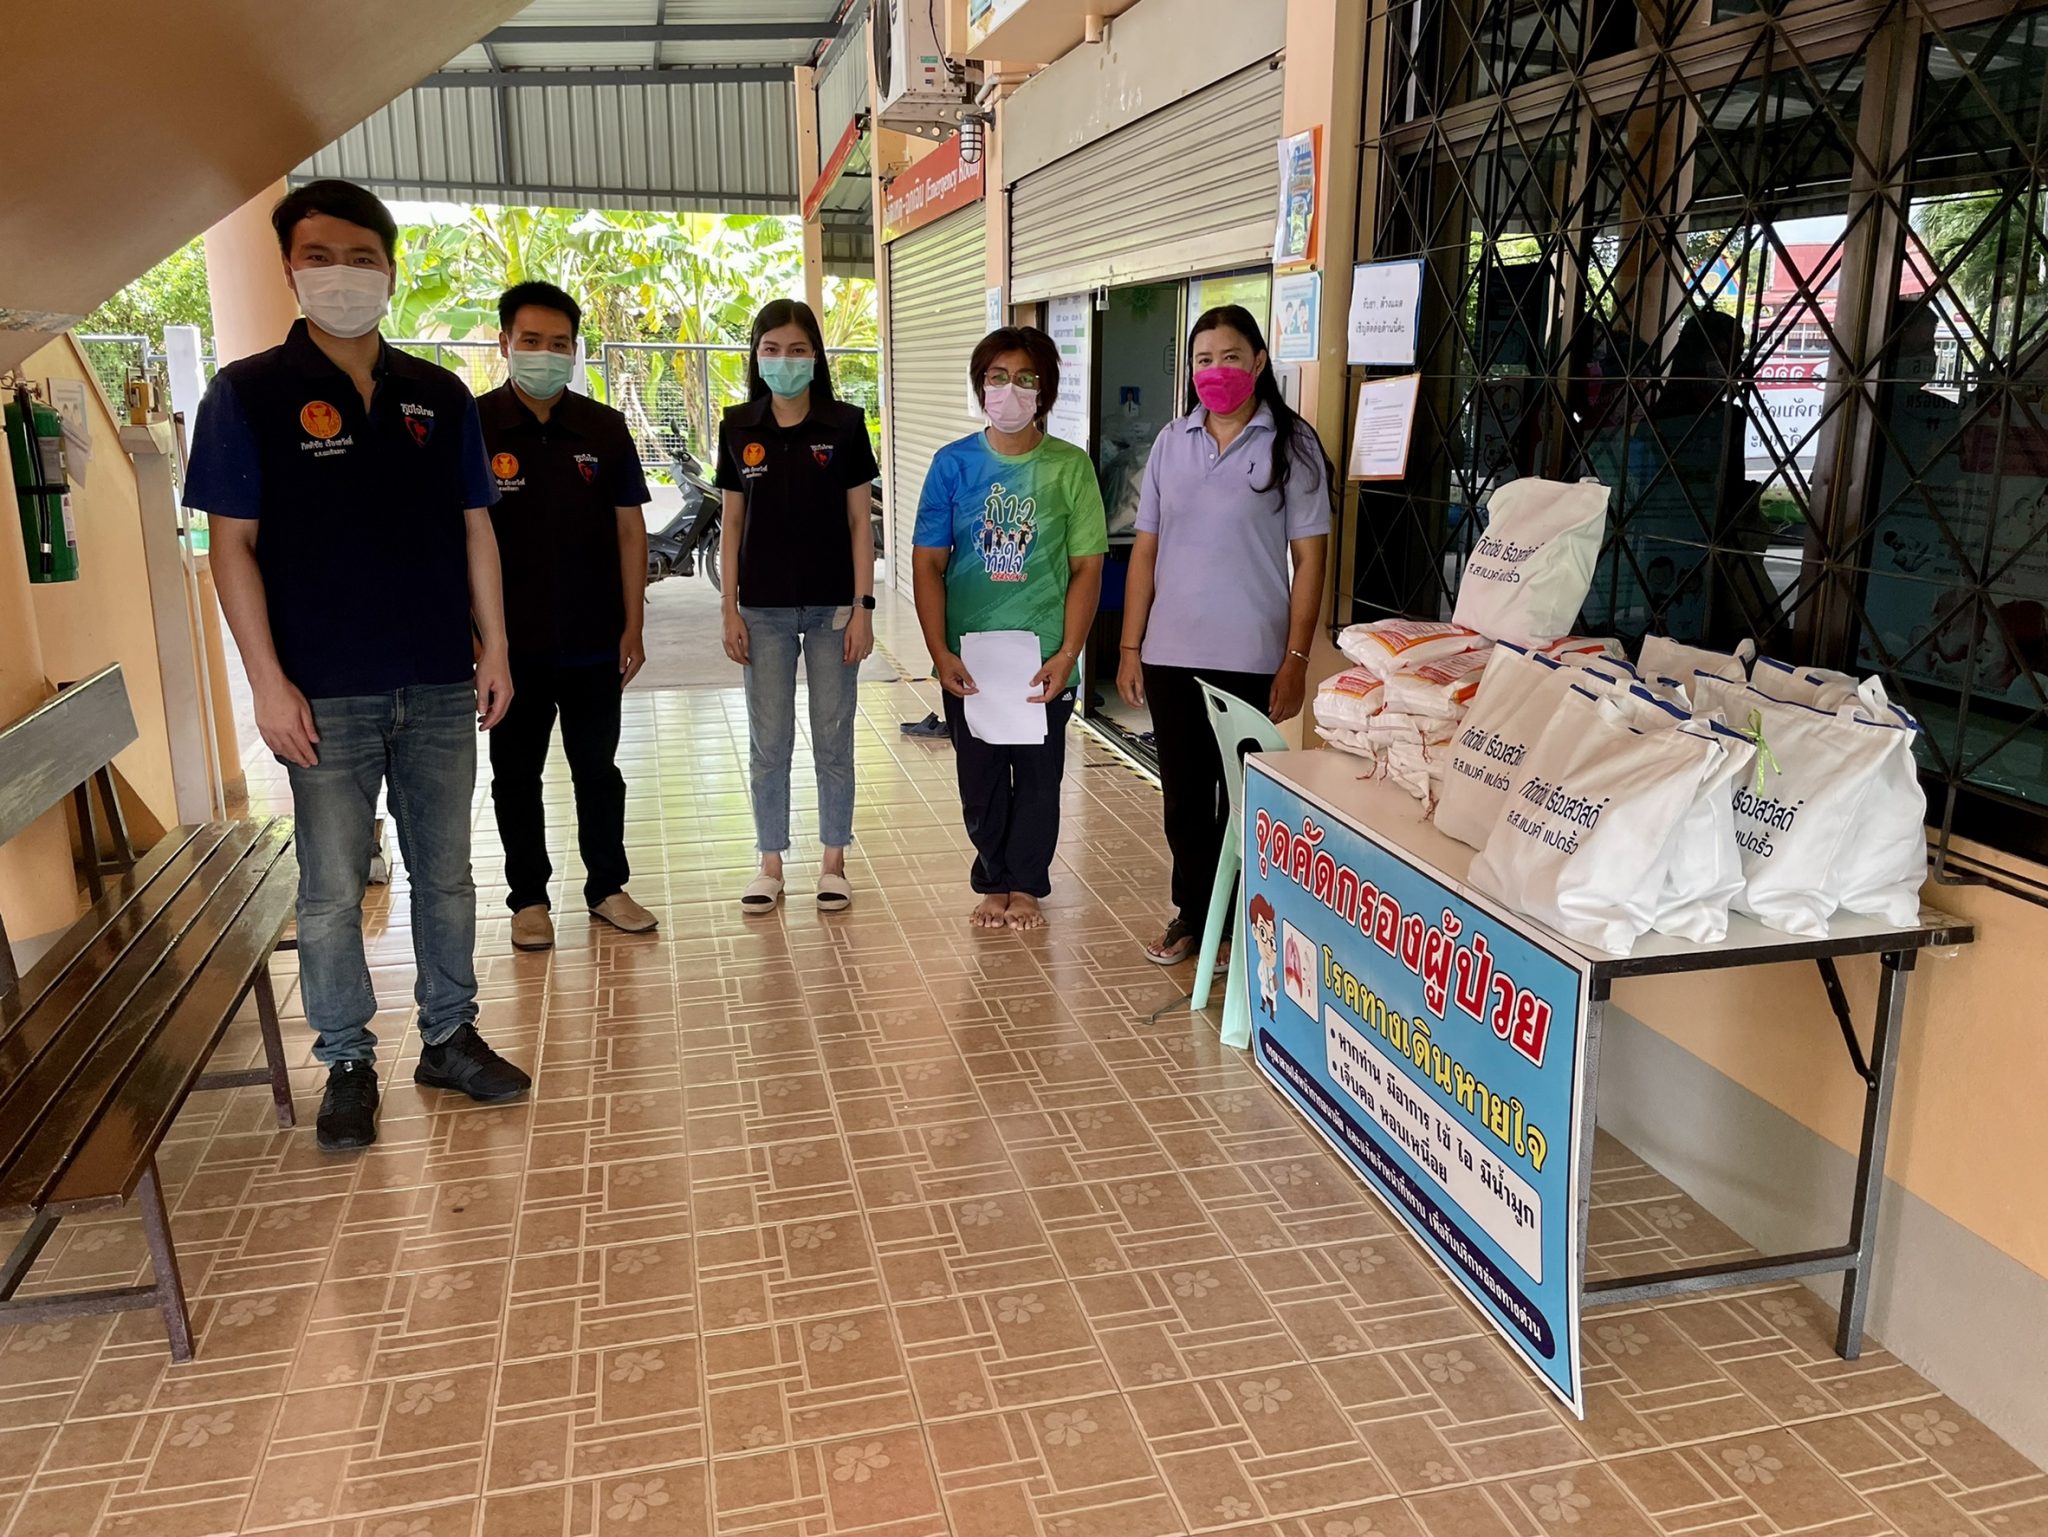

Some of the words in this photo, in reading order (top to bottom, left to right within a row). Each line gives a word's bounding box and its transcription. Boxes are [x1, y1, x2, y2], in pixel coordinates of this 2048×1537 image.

[925, 168, 958, 208] (Emergency
[985, 483, 1036, 526] ก้าว
[985, 542, 1024, 573] ท้าใจ
[1544, 786, 1610, 830] เรืองสวัสดิ์
[1732, 785, 1804, 832] เรืองสวัสดิ์
[1543, 830, 1579, 855] แปดริ้ว
[1735, 830, 1774, 857] แปดริ้ว
[1255, 808, 1552, 1069] จุดคัดกรองผู้ป่วย
[1321, 944, 1548, 1173] โรคทางเดินหายใจ
[1338, 1033, 1381, 1085] หากท่าน
[1386, 1072, 1430, 1131] มีอาการ
[1435, 1118, 1451, 1151] ไข้
[1456, 1137, 1473, 1171] ไอ
[1480, 1158, 1535, 1229] มีน้ำมูก
[1340, 1062, 1375, 1112] เจ็บคอ
[1379, 1104, 1448, 1184] หอบเหนื่อย
[1428, 1210, 1542, 1342] เพื่อรับบริการช่องทางด่วน
